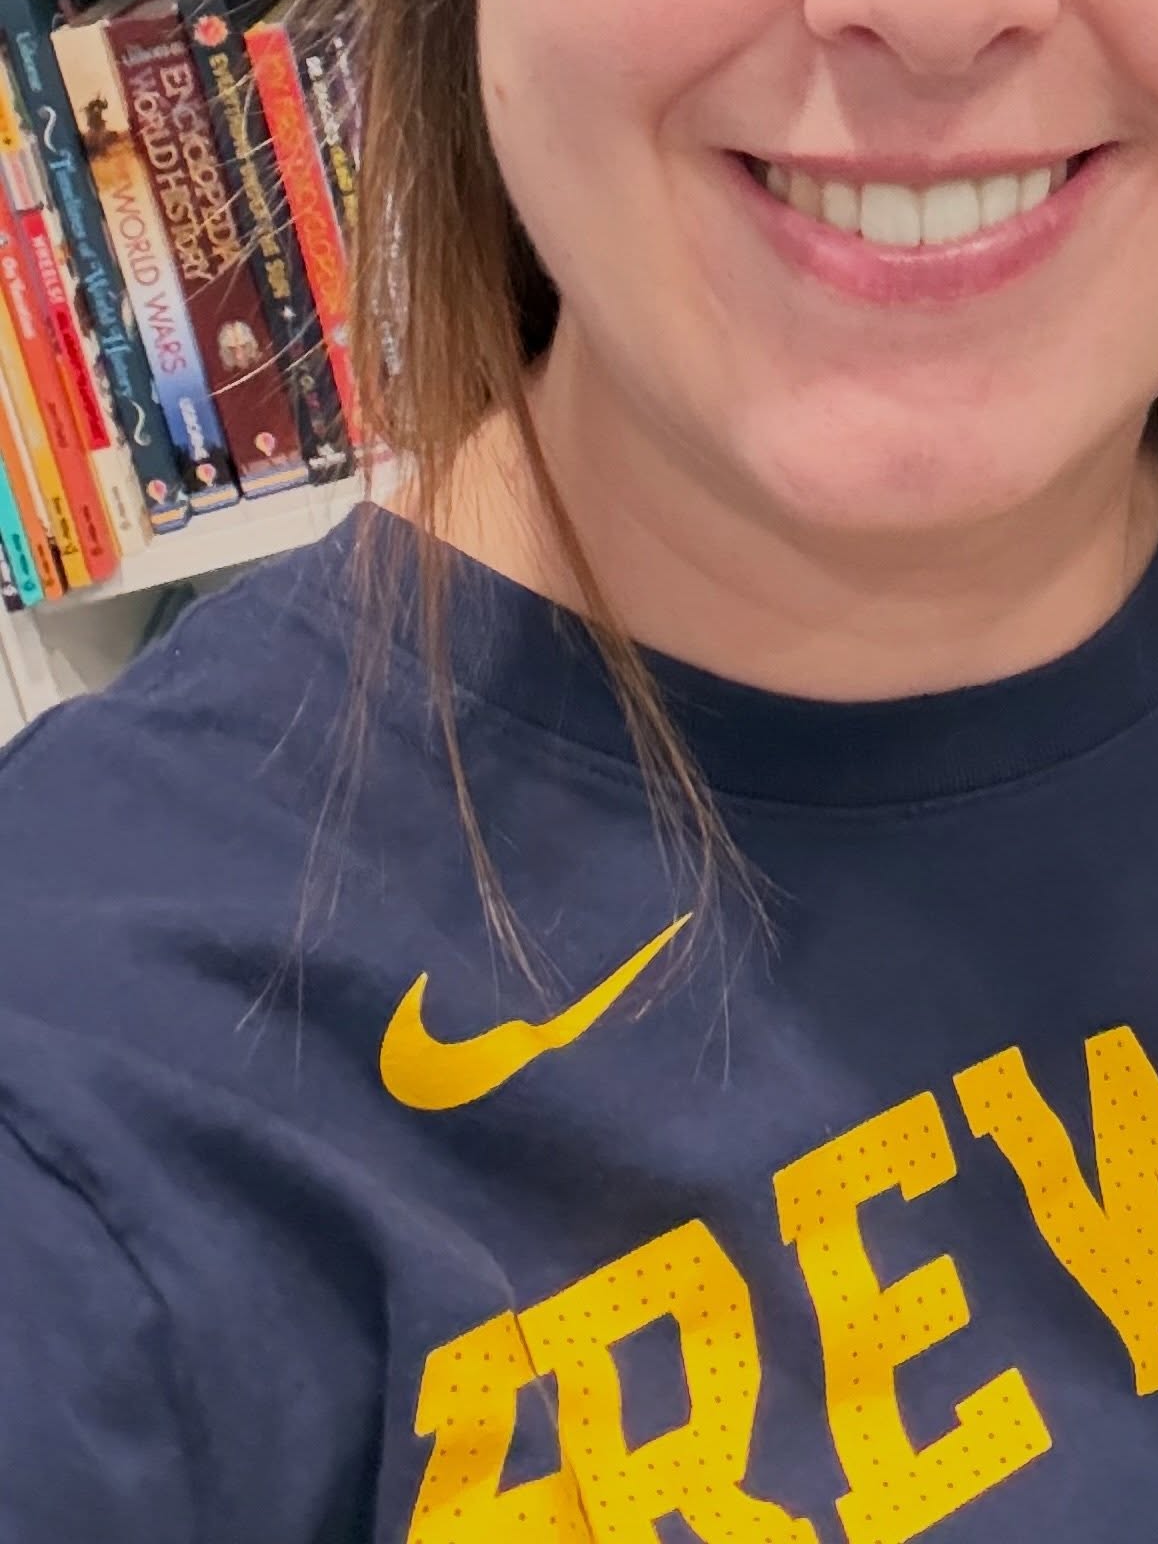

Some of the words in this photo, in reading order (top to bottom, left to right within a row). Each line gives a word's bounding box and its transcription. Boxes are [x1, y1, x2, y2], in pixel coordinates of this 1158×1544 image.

[108, 181, 161, 289] WORLD
[140, 291, 188, 377] WARS
[125, 66, 179, 172] WORLD
[155, 167, 213, 288] HISTORY
